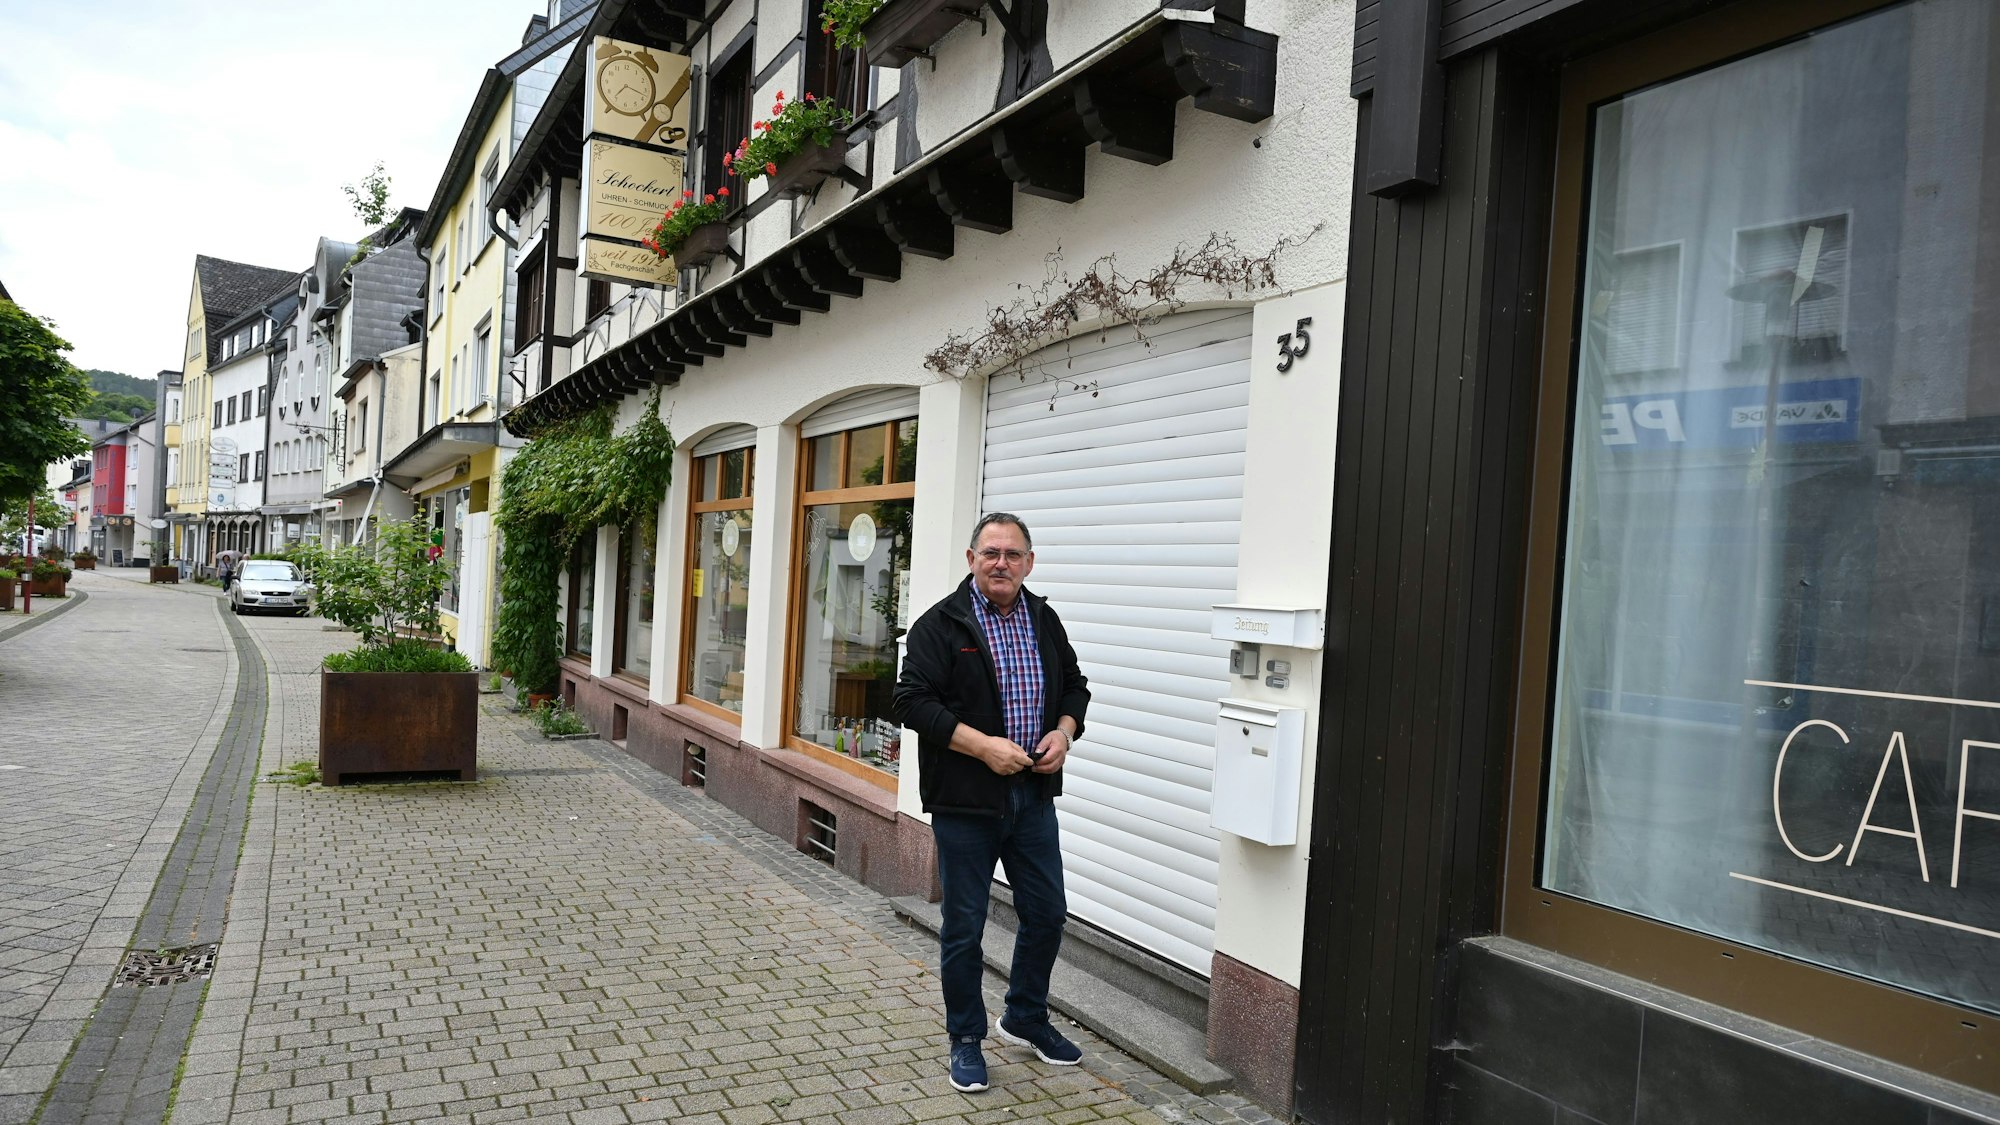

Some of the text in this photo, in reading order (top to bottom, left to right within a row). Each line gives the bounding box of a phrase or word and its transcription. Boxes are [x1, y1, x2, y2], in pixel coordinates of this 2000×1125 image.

[597, 169, 675, 197] Schockert
[601, 192, 628, 203] UHREN
[633, 198, 670, 210] SCHMUCK
[598, 212, 636, 229] 100
[600, 249, 628, 261] seit
[1276, 317, 1312, 373] 35
[1234, 616, 1270, 636] Zeitung
